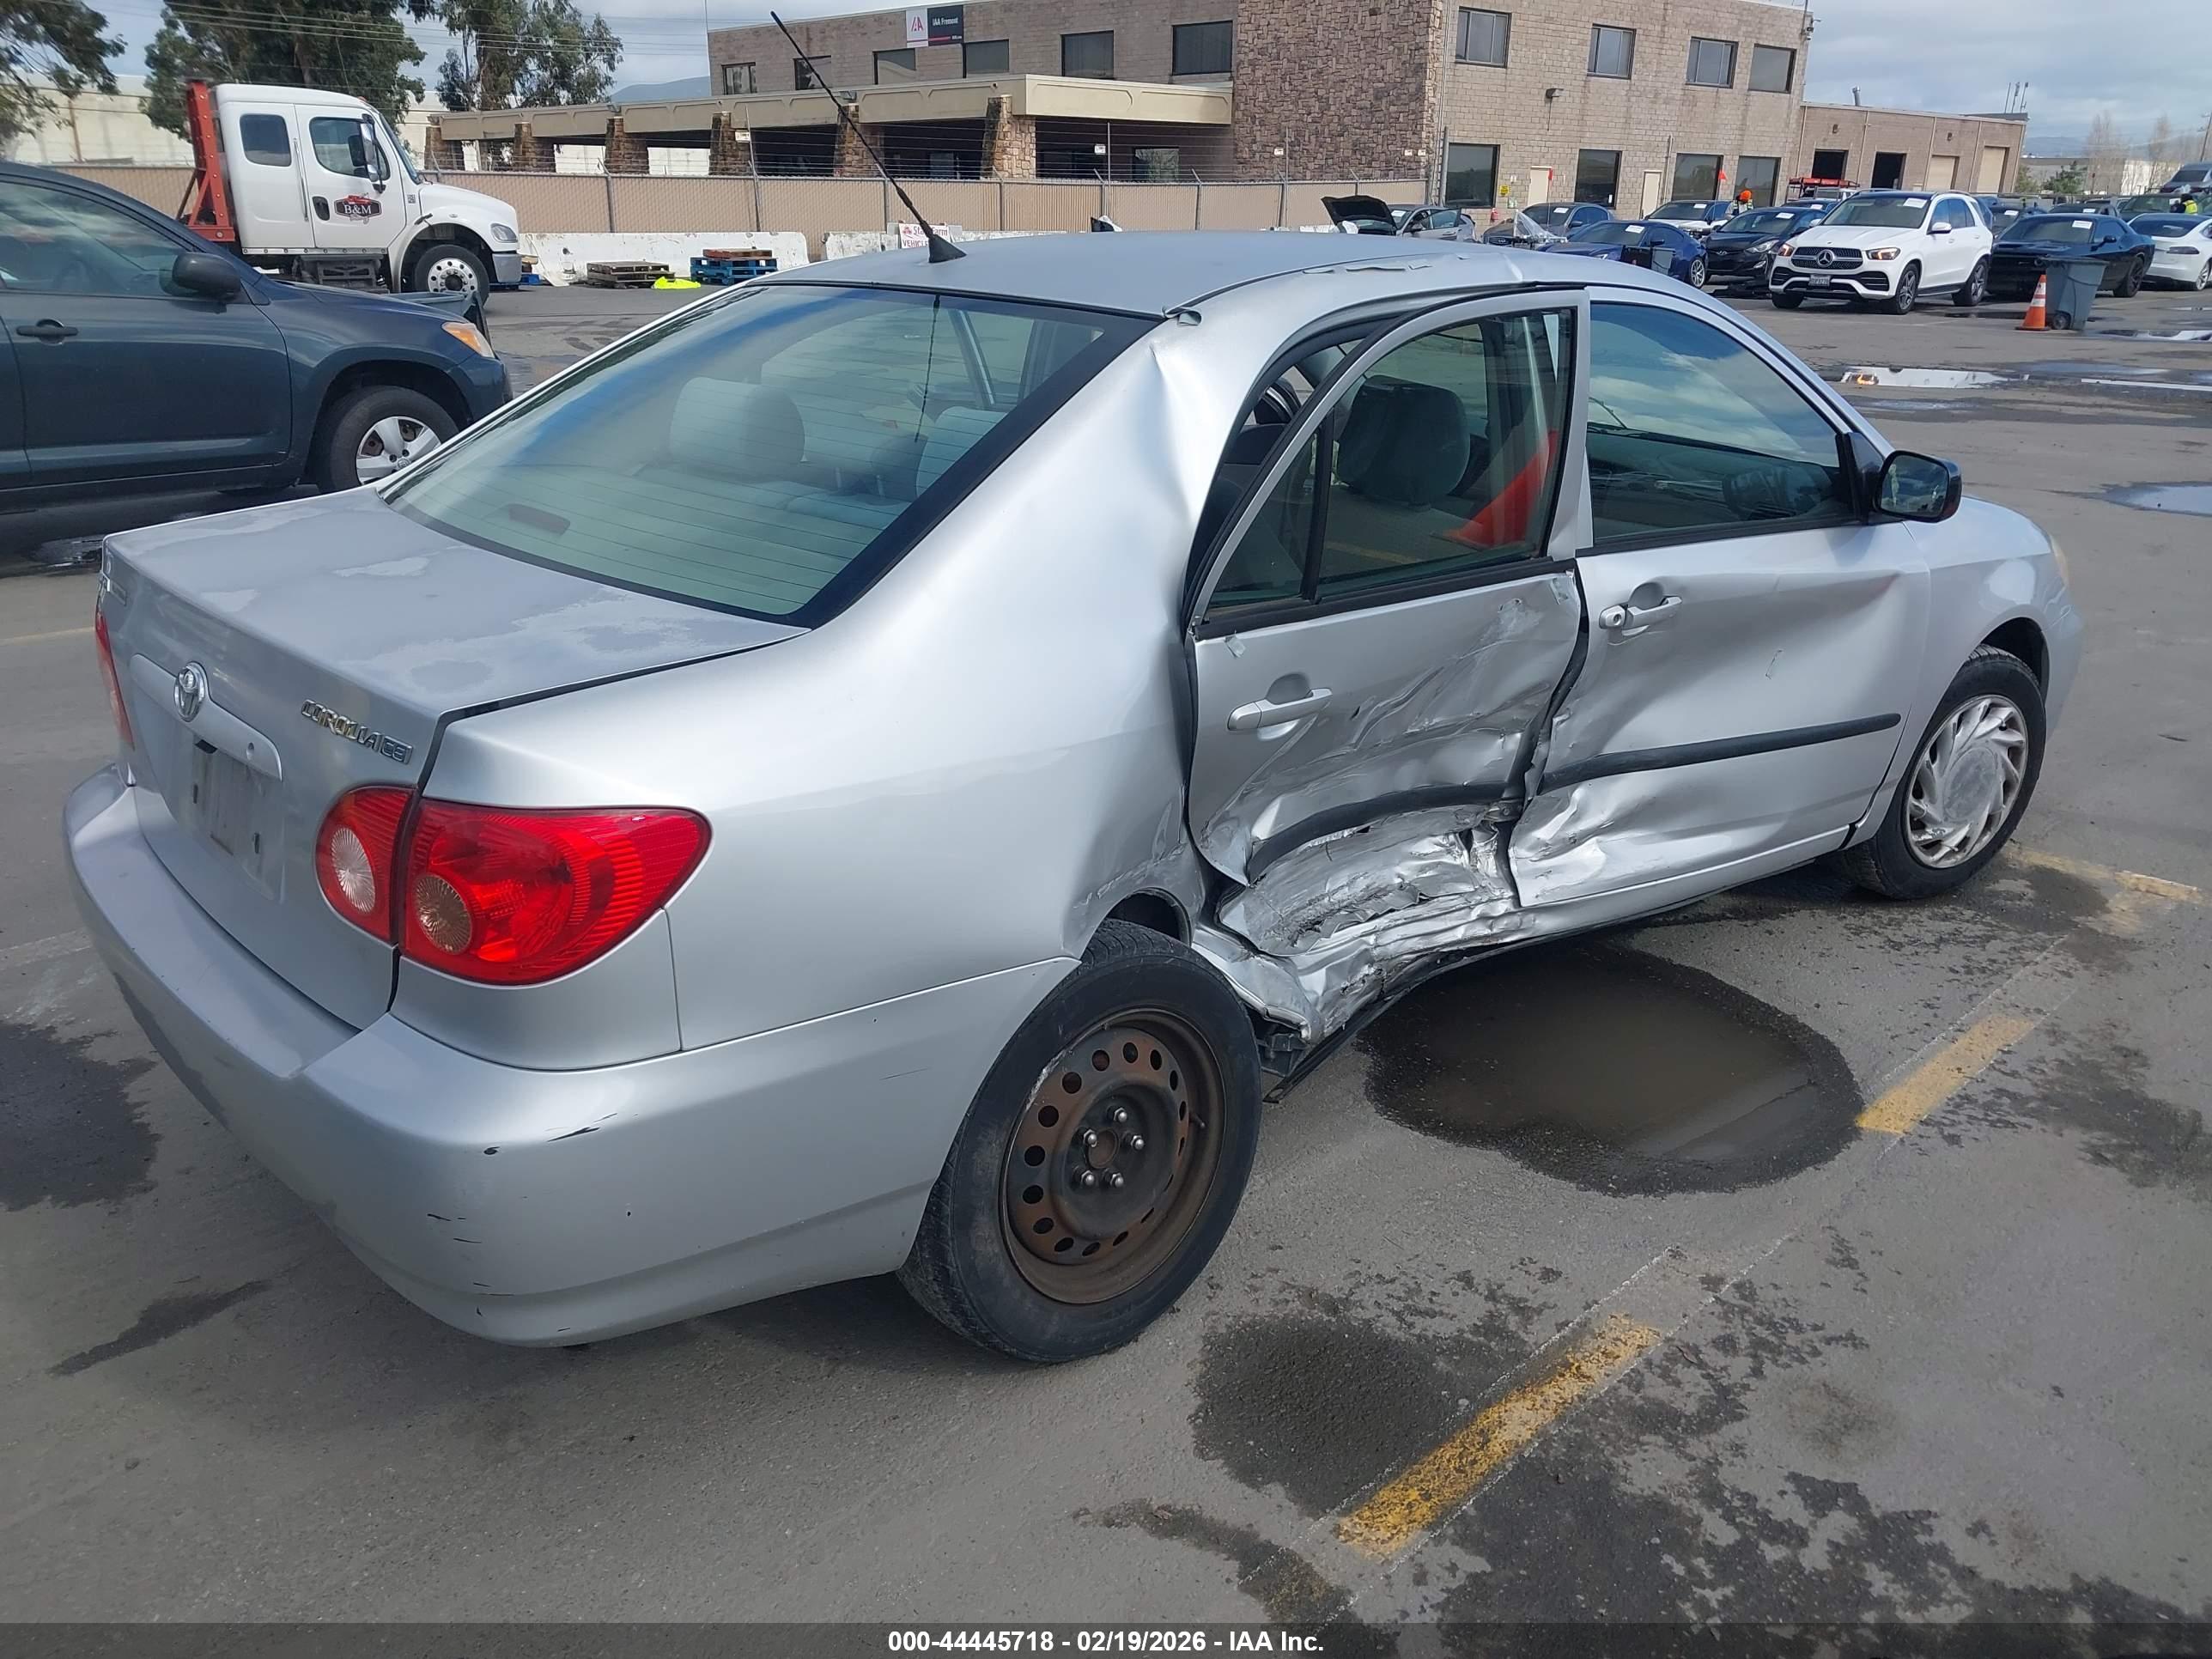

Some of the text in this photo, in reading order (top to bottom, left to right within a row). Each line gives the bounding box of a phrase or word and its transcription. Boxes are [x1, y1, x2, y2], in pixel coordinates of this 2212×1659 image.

[932, 17, 958, 27] IAA Fremont
[344, 204, 372, 215] B&M
[301, 699, 412, 765] COROLLA CE
